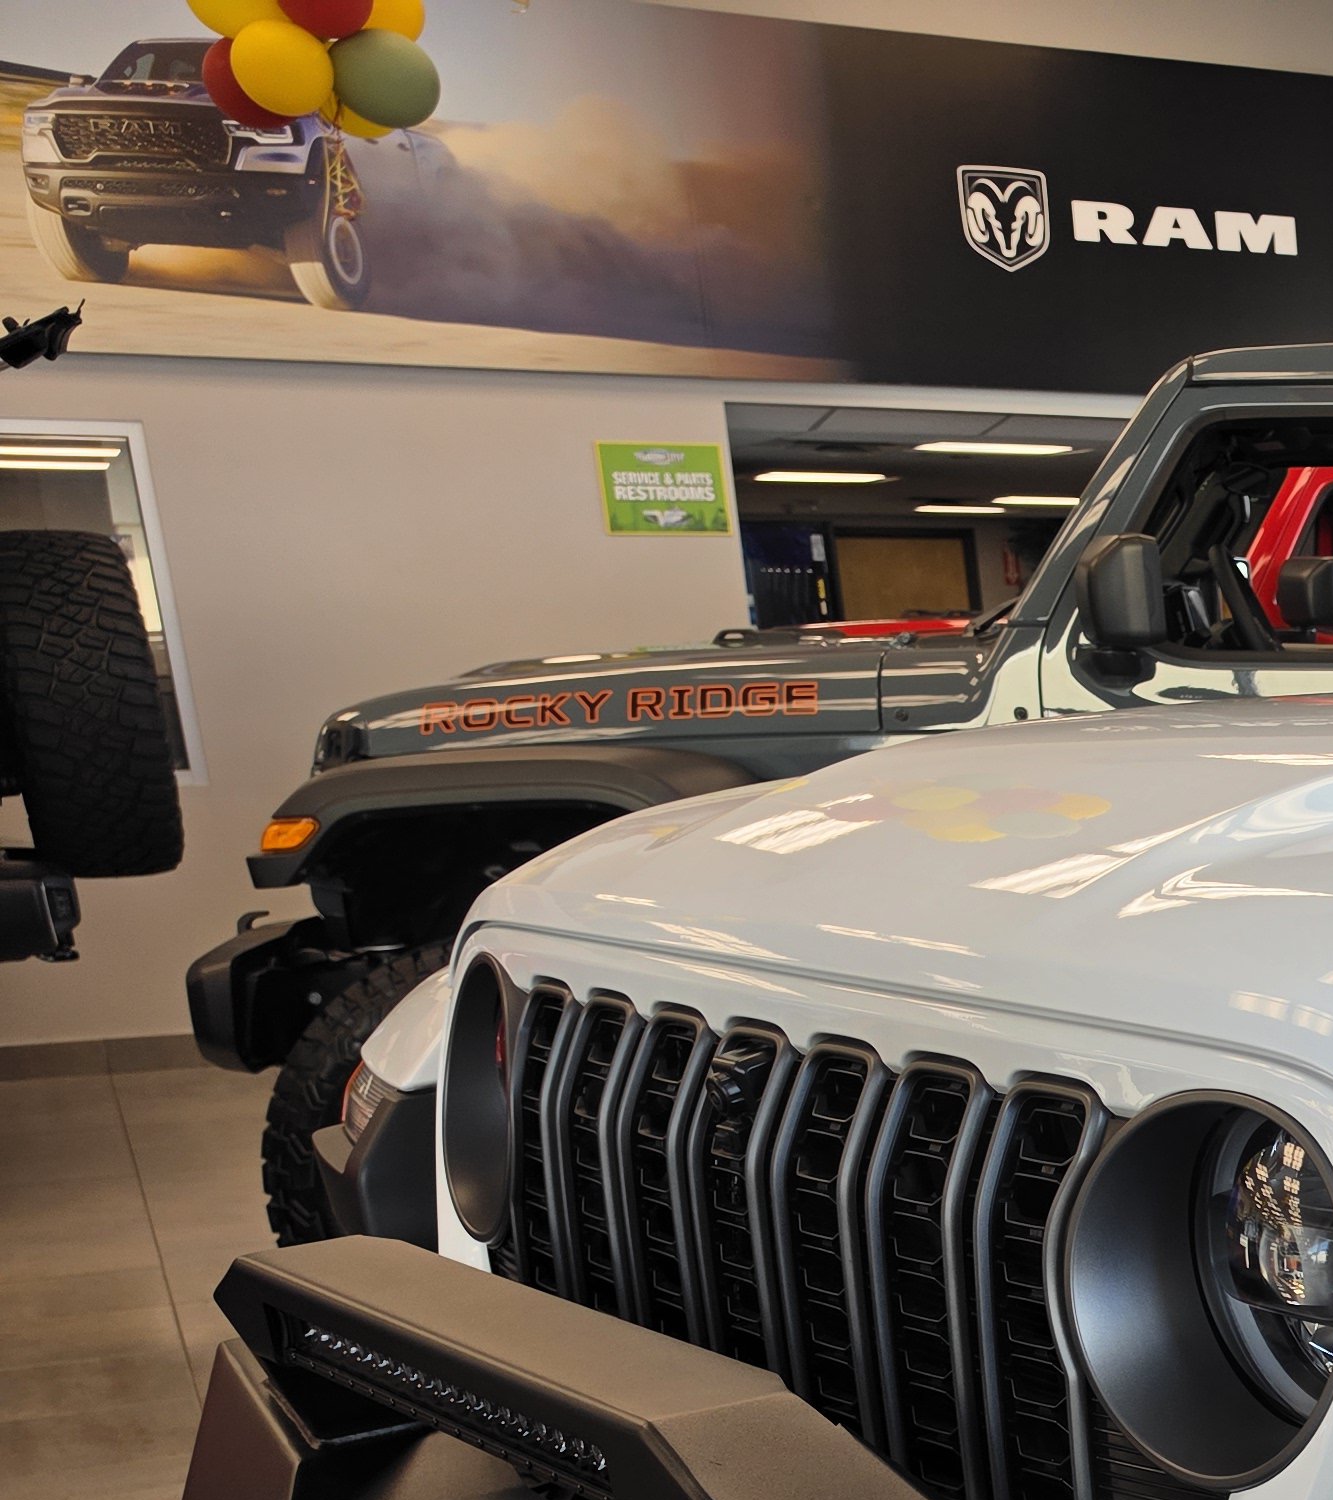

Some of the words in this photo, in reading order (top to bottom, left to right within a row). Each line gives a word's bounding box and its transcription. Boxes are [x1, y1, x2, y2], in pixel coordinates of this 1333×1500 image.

[90, 118, 181, 135] RAM
[1071, 200, 1298, 256] RAM
[612, 471, 660, 486] SERVICE
[663, 472, 673, 486] &
[675, 472, 713, 486] PARTS
[614, 486, 716, 502] RESTROOMS
[420, 688, 614, 736] ROCKY
[627, 681, 819, 722] RIDGE
